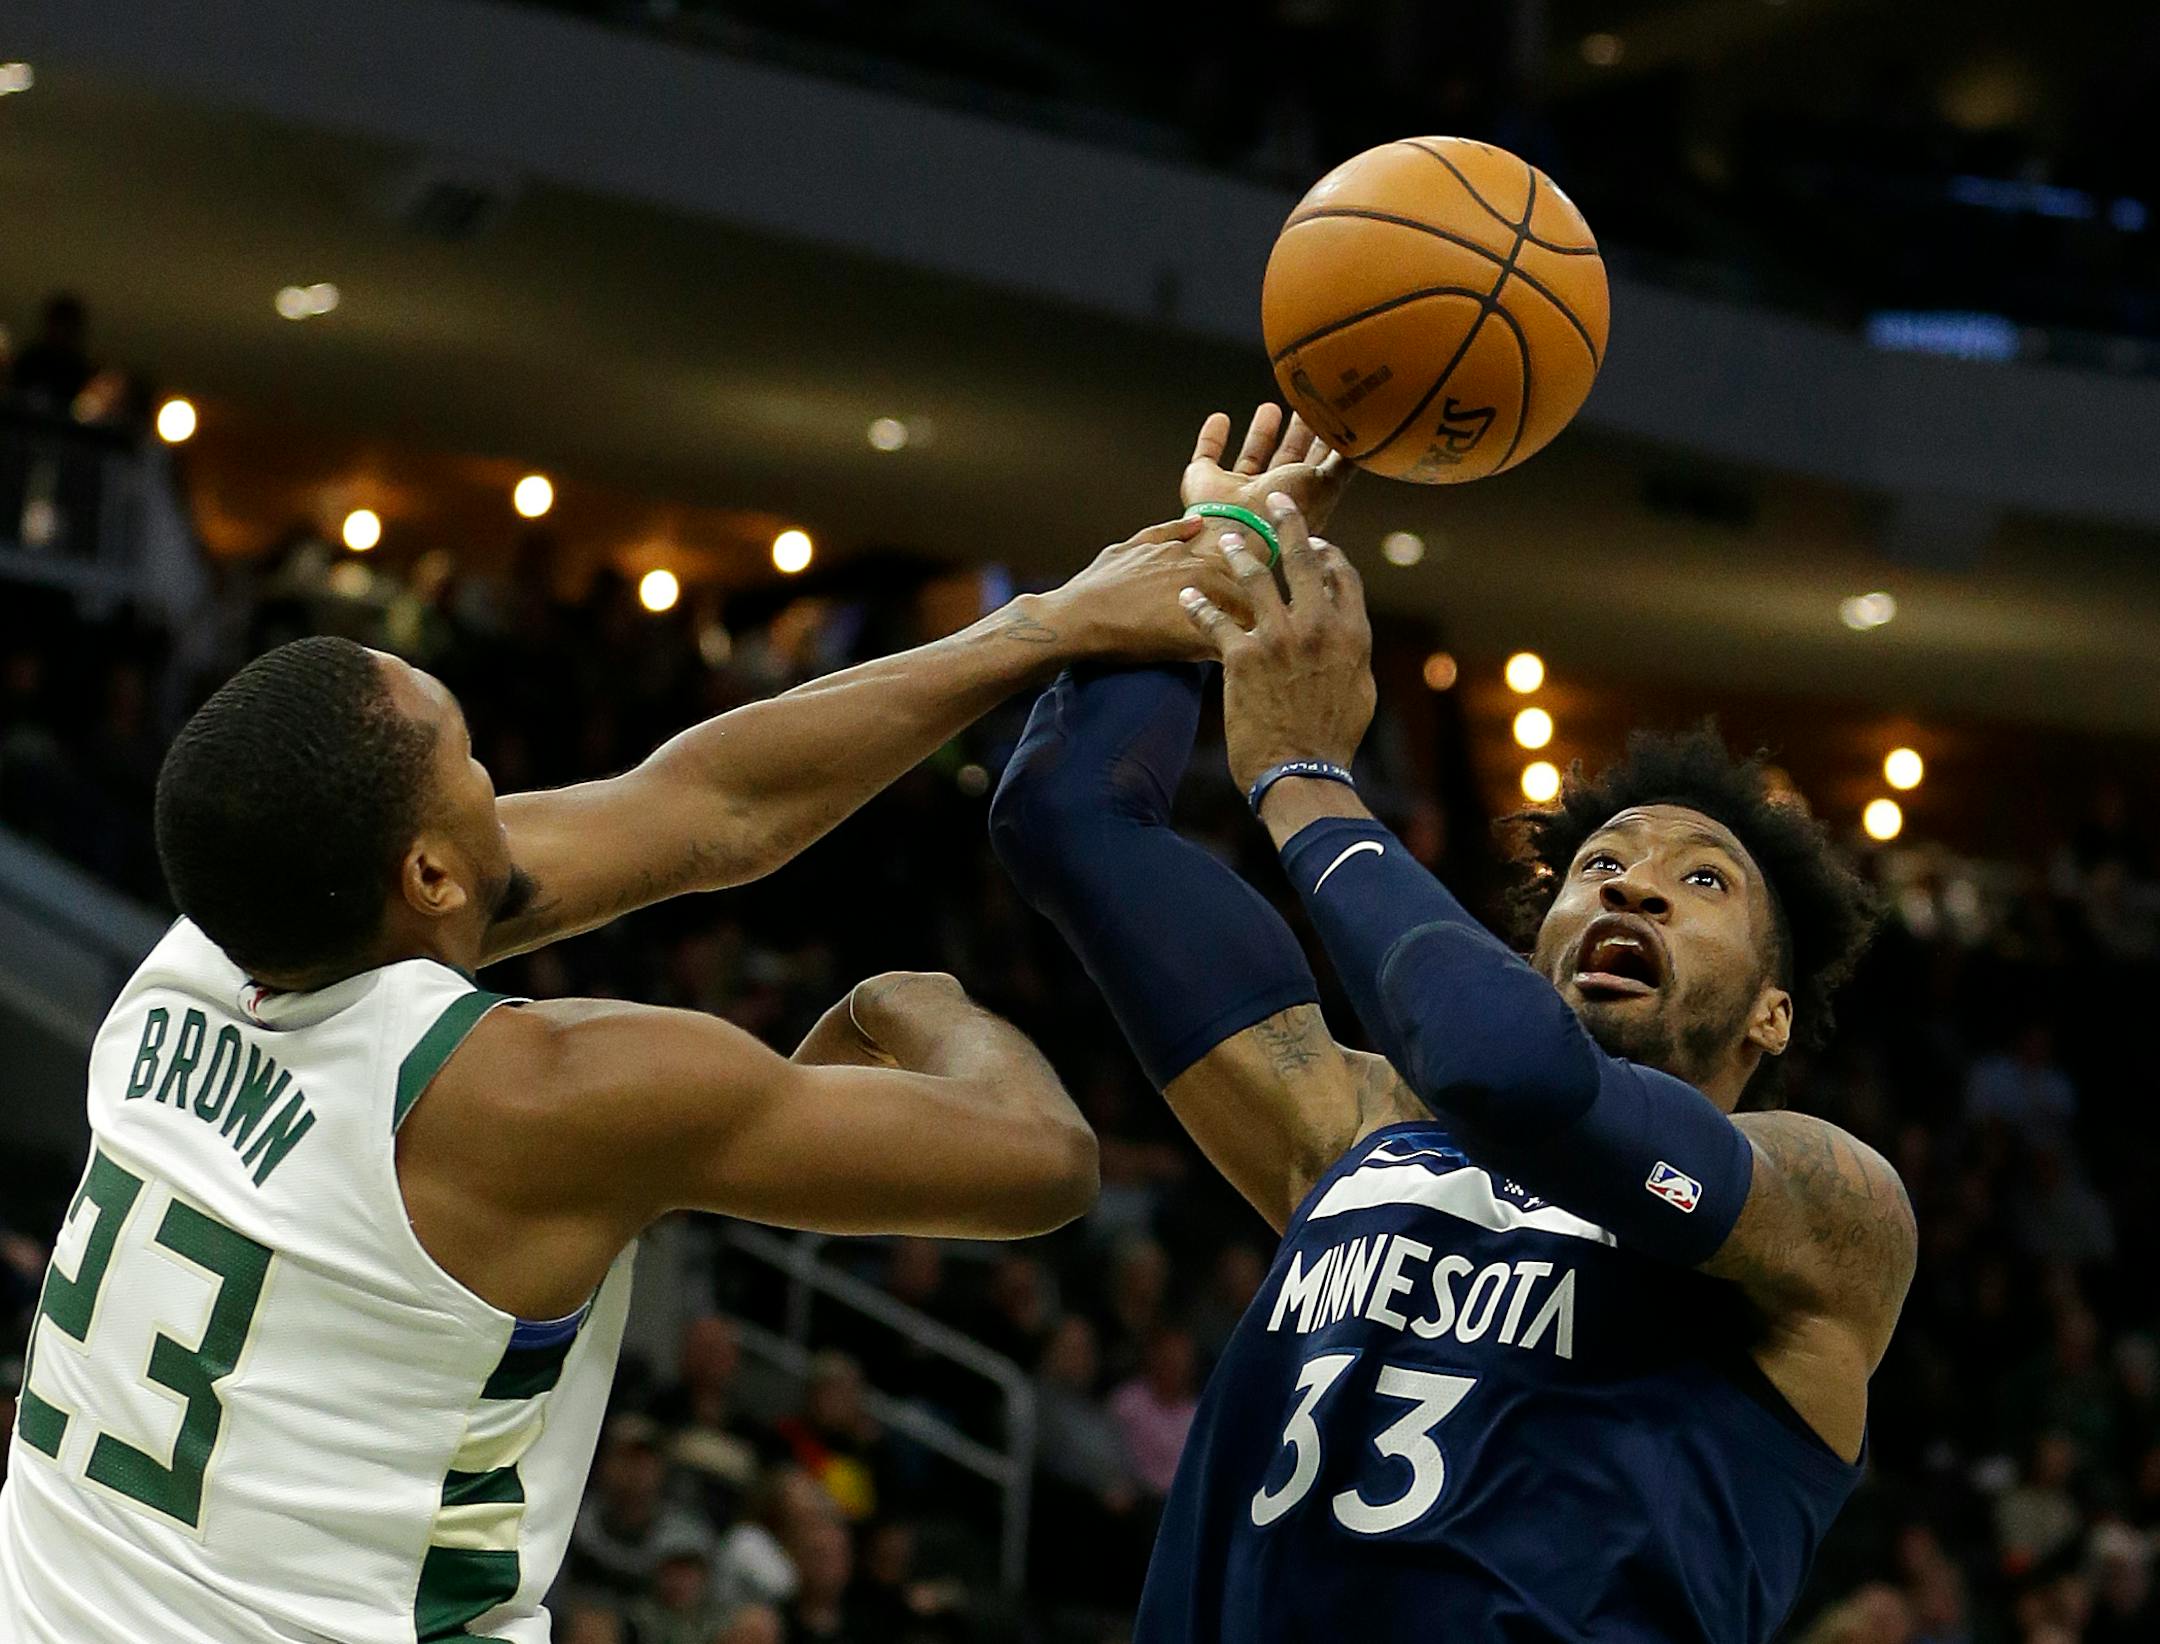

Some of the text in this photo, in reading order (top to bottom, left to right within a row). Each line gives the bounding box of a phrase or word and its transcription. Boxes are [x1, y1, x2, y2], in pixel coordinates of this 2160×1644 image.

[125, 1006, 316, 1188] BROWN
[18, 1148, 274, 1529] 23
[1266, 1233, 1576, 1360] MINNESOTA
[1250, 1354, 1478, 1535] 33
